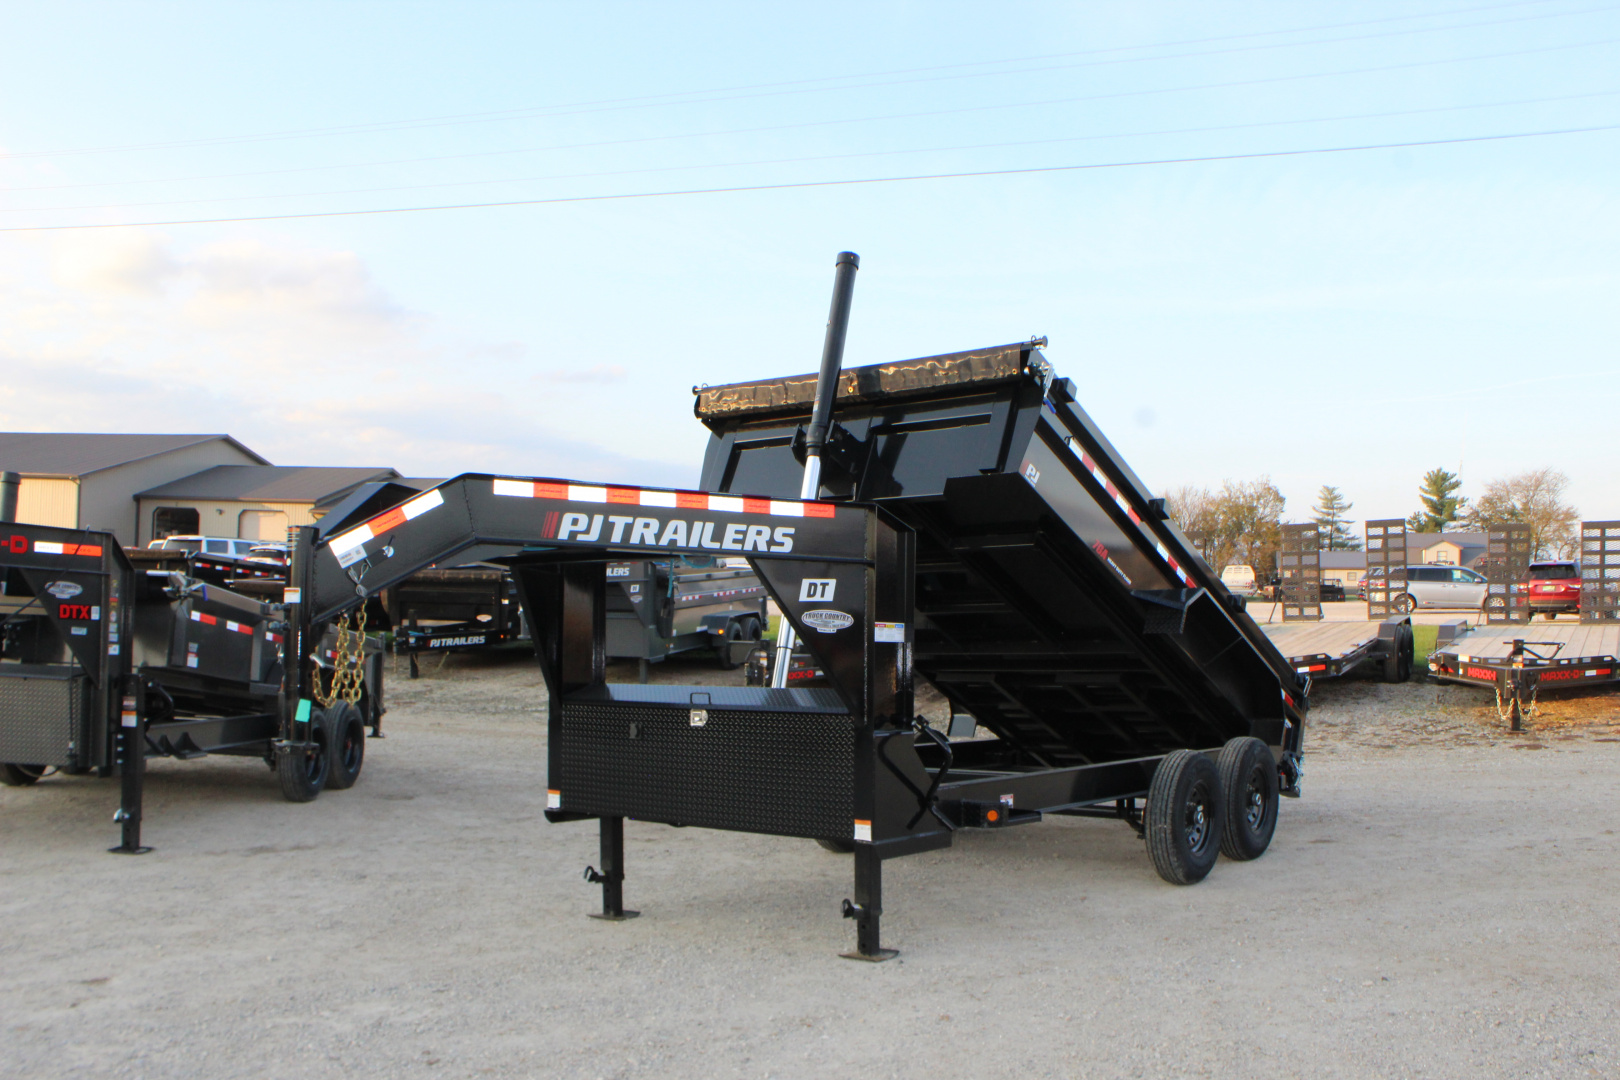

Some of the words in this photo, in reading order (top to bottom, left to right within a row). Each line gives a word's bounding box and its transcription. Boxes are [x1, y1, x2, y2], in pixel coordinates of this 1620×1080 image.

[1025, 463, 1040, 484] PJ
[557, 512, 603, 541] PJ
[608, 516, 795, 553] TRAILERS
[606, 567, 630, 577] ILERS
[806, 582, 829, 598] DT
[59, 604, 90, 619] DTX
[824, 612, 849, 621] COUNTRY
[430, 639, 440, 648] PJ
[441, 635, 486, 645] TRAILERS
[1540, 669, 1580, 682] MAXX-D
